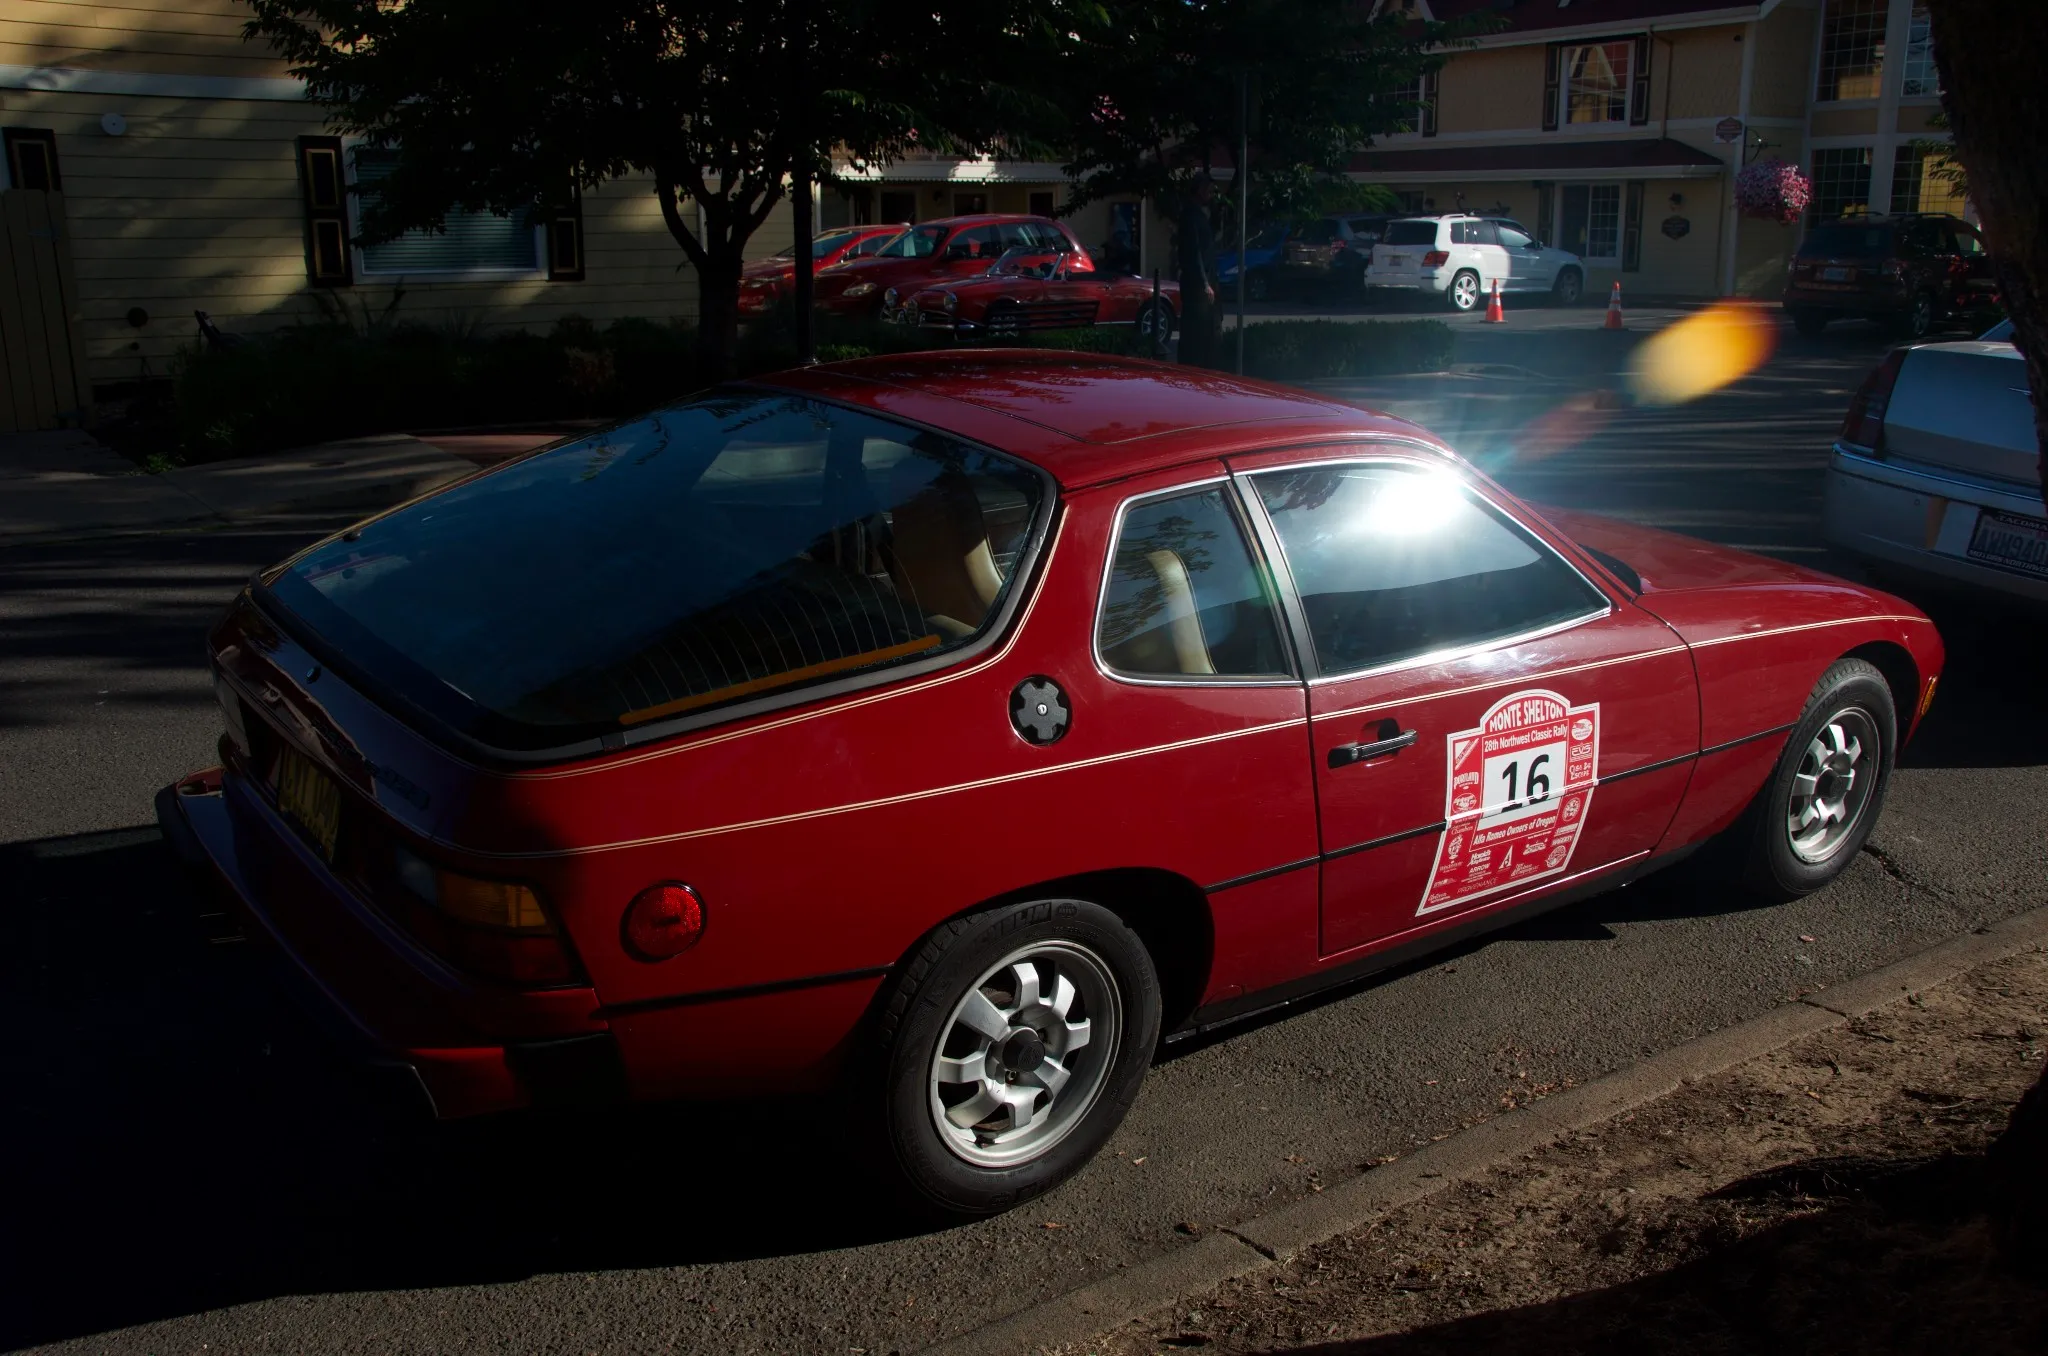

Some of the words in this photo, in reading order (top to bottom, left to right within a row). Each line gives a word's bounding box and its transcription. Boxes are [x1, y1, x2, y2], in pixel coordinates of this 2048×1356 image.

[1490, 702, 1521, 732] MONTE
[1524, 699, 1563, 725] SHELTON
[1484, 740, 1499, 753] 28th
[1500, 732, 1530, 749] Northwest
[1531, 728, 1552, 742] Classic
[1553, 724, 1568, 738] Rally
[1502, 754, 1549, 813] 16
[1473, 833, 1486, 846] Alfa
[1486, 829, 1506, 842] Romeo
[1507, 822, 1528, 837] Owners
[1529, 819, 1537, 830] of
[1536, 816, 1556, 829] Oregon
